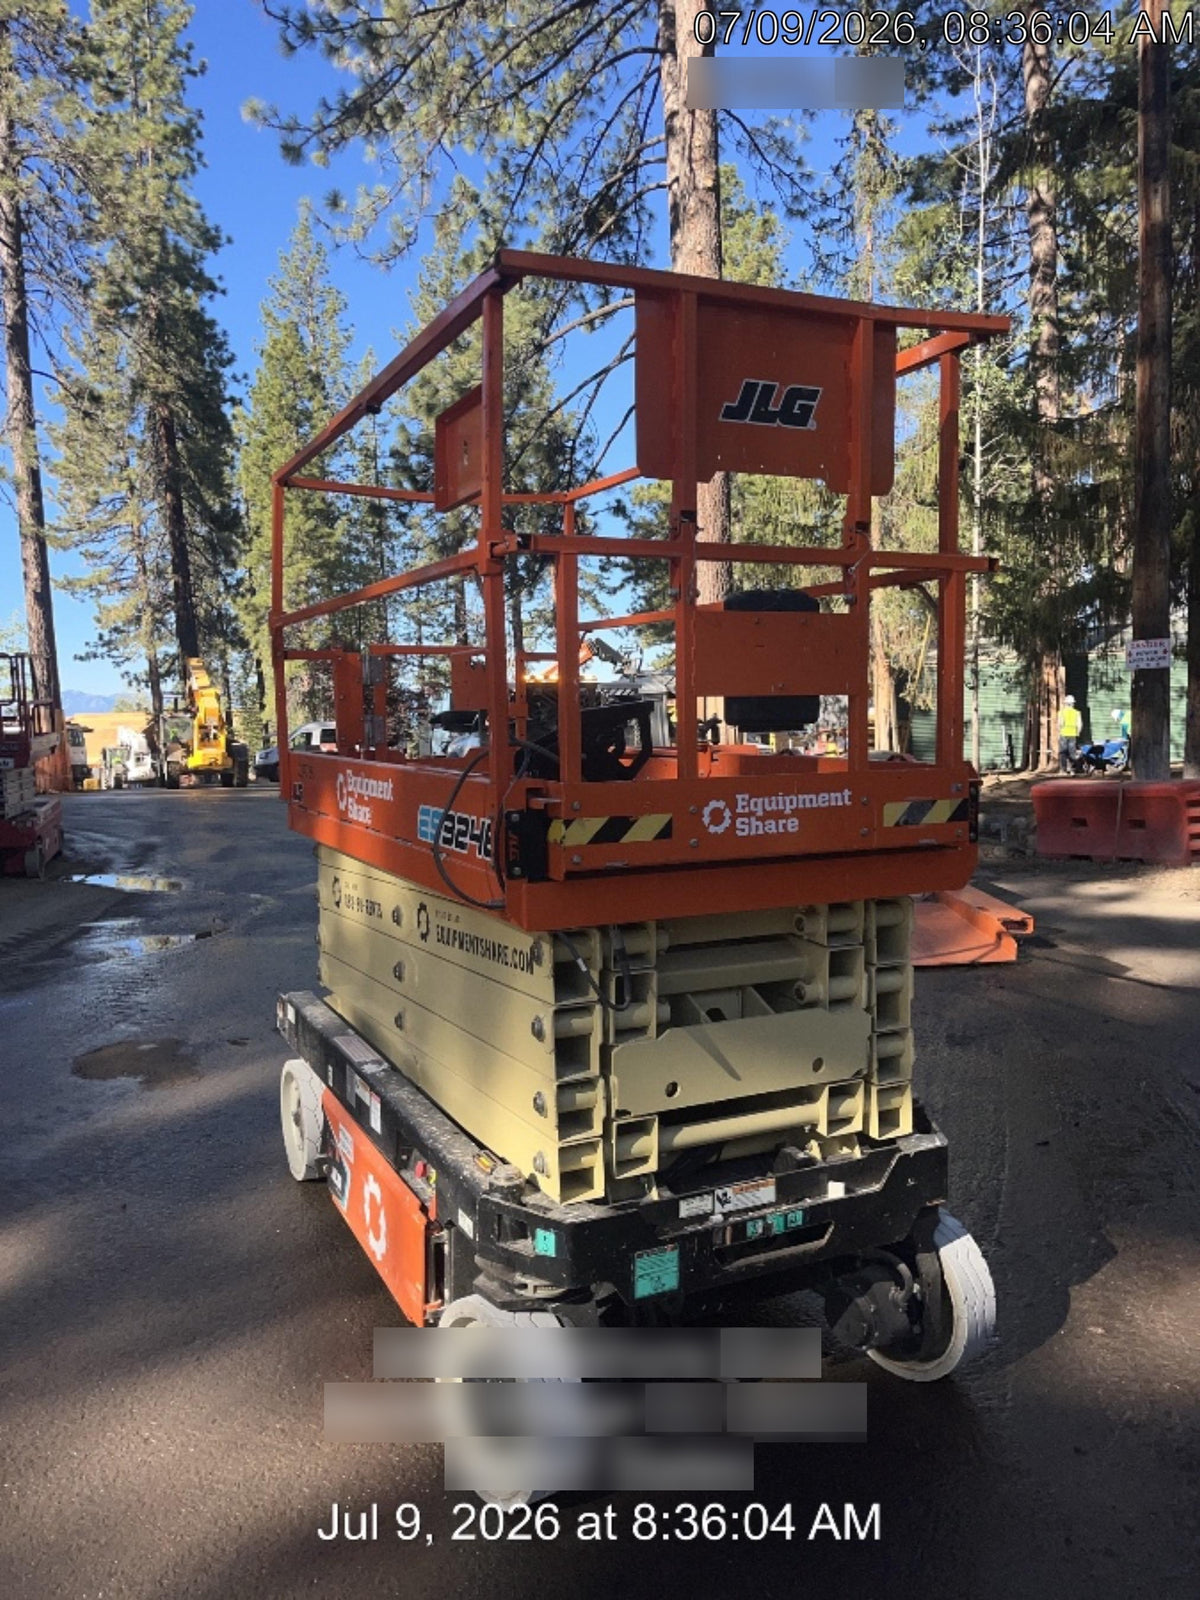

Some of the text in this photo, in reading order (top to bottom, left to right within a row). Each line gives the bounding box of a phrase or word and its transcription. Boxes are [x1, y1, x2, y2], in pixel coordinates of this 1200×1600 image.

[718, 378, 823, 430] JLG
[346, 768, 393, 802] Equipment
[347, 796, 372, 825] Share
[735, 788, 852, 816] Equipment
[735, 817, 799, 836] Share
